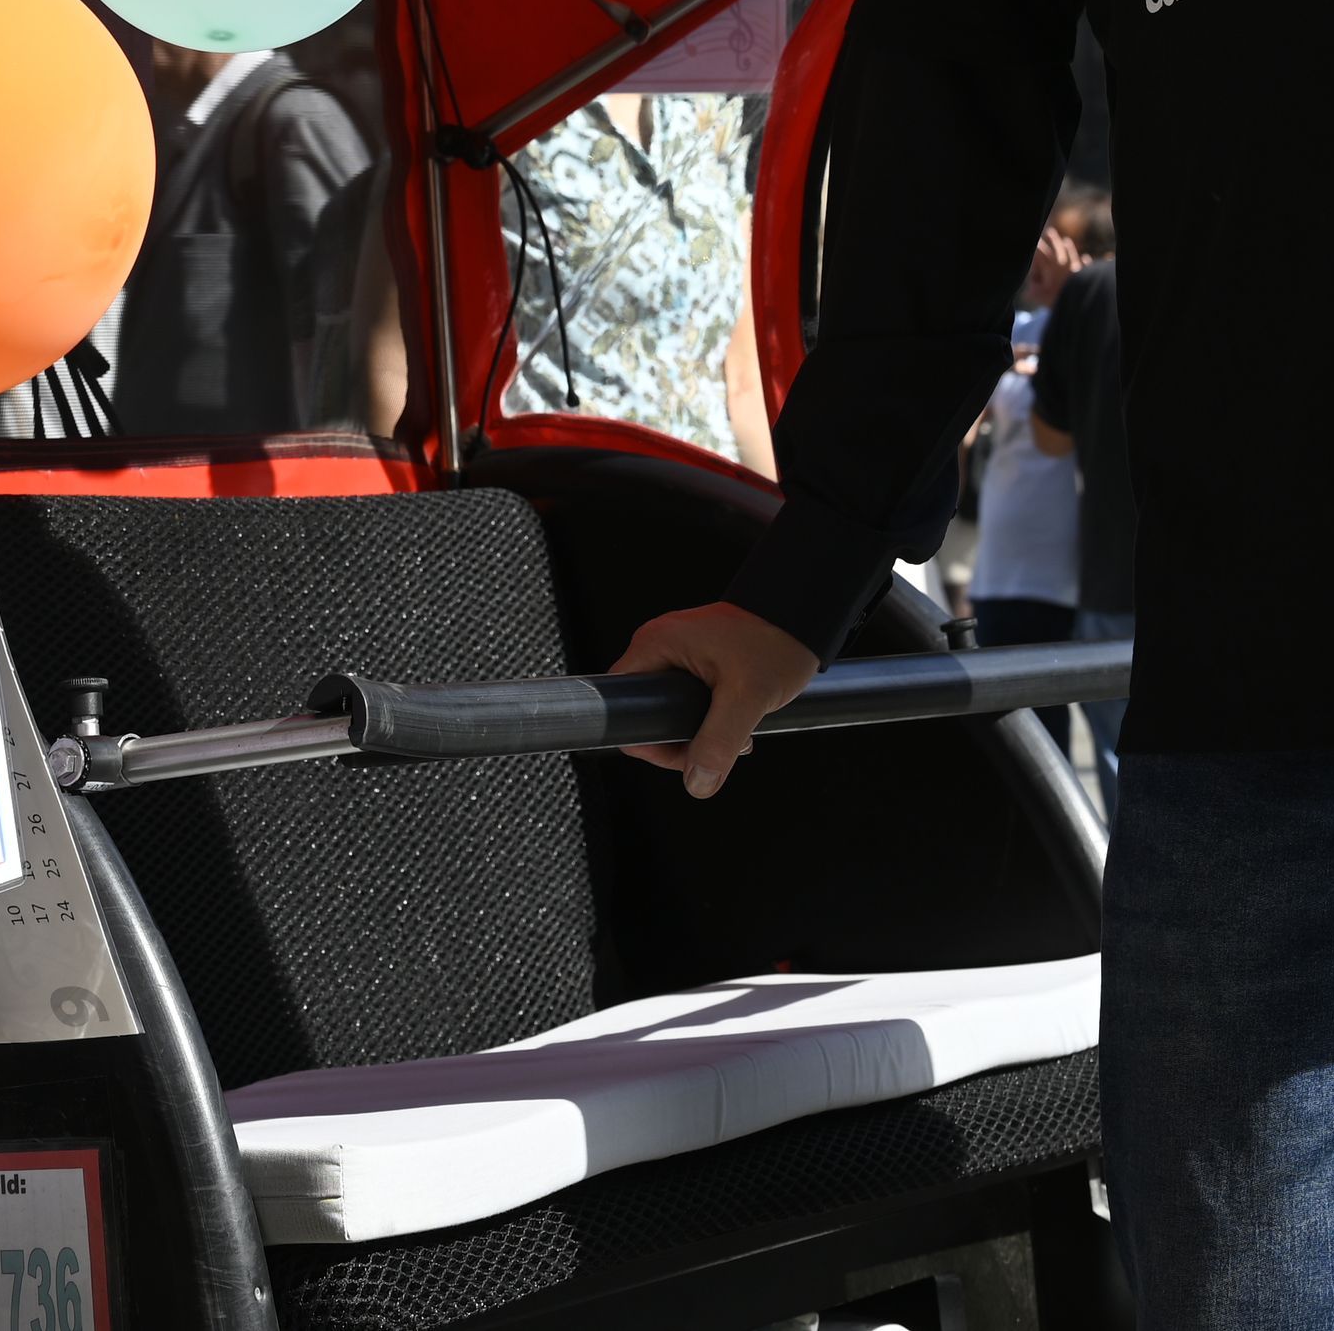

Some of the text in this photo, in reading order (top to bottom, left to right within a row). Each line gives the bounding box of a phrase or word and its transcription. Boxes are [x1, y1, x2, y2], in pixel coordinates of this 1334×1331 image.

[13, 771, 31, 791] 27
[28, 813, 45, 835] 26
[43, 857, 61, 879] 25
[7, 905, 24, 926] 10
[32, 903, 49, 924] 17
[57, 900, 75, 921] 24
[0, 1247, 82, 1331] 736
